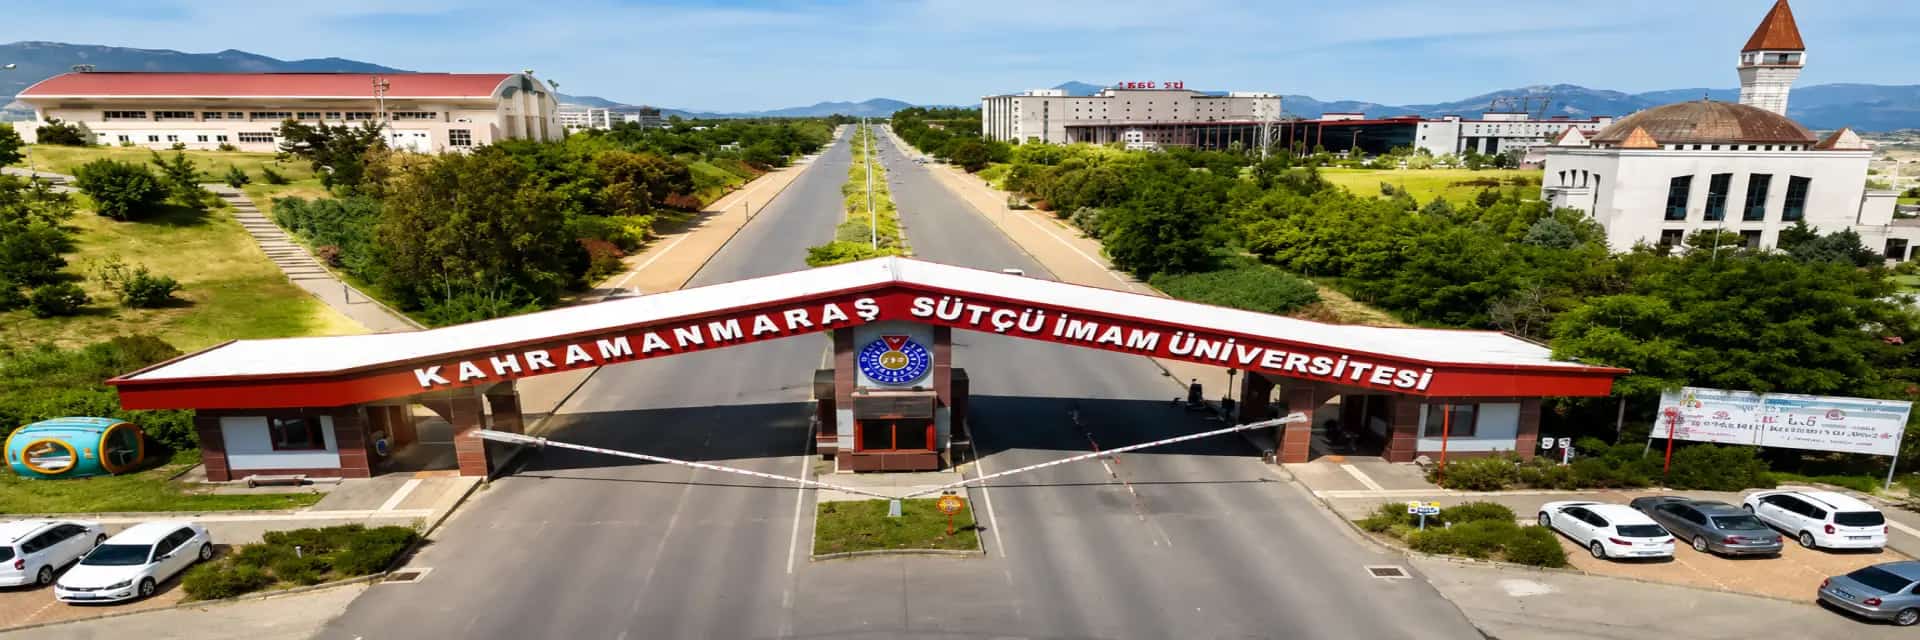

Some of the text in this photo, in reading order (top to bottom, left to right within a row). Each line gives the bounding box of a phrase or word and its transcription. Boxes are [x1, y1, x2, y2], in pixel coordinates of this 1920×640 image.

[414, 297, 881, 388] KAHRAMANMARAŞ
[910, 295, 1047, 333] SÜTÇÜ
[1053, 314, 1162, 352] İMAM
[1168, 331, 1435, 392] ÜNİVERSİTESİ
